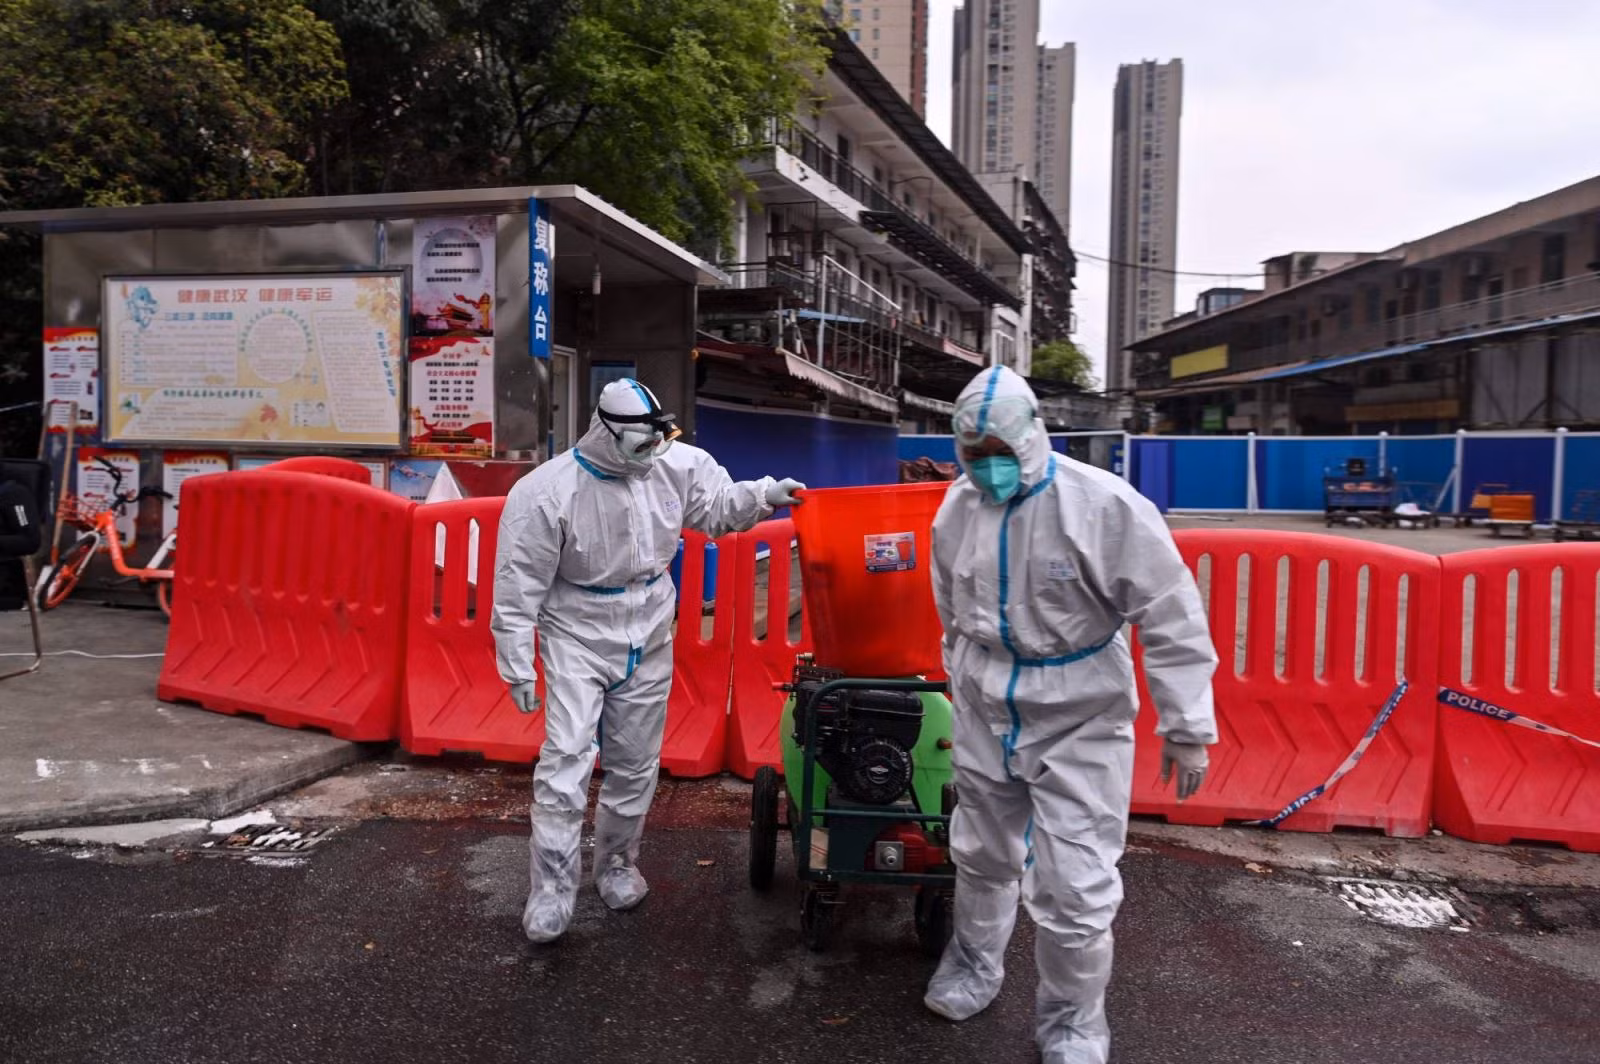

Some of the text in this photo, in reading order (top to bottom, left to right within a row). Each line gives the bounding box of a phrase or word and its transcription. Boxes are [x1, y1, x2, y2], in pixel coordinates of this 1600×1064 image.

[533, 215, 549, 341] 复称台
[177, 287, 332, 303] 健康武汉 健康军运
[1447, 691, 1511, 719] POLICE
